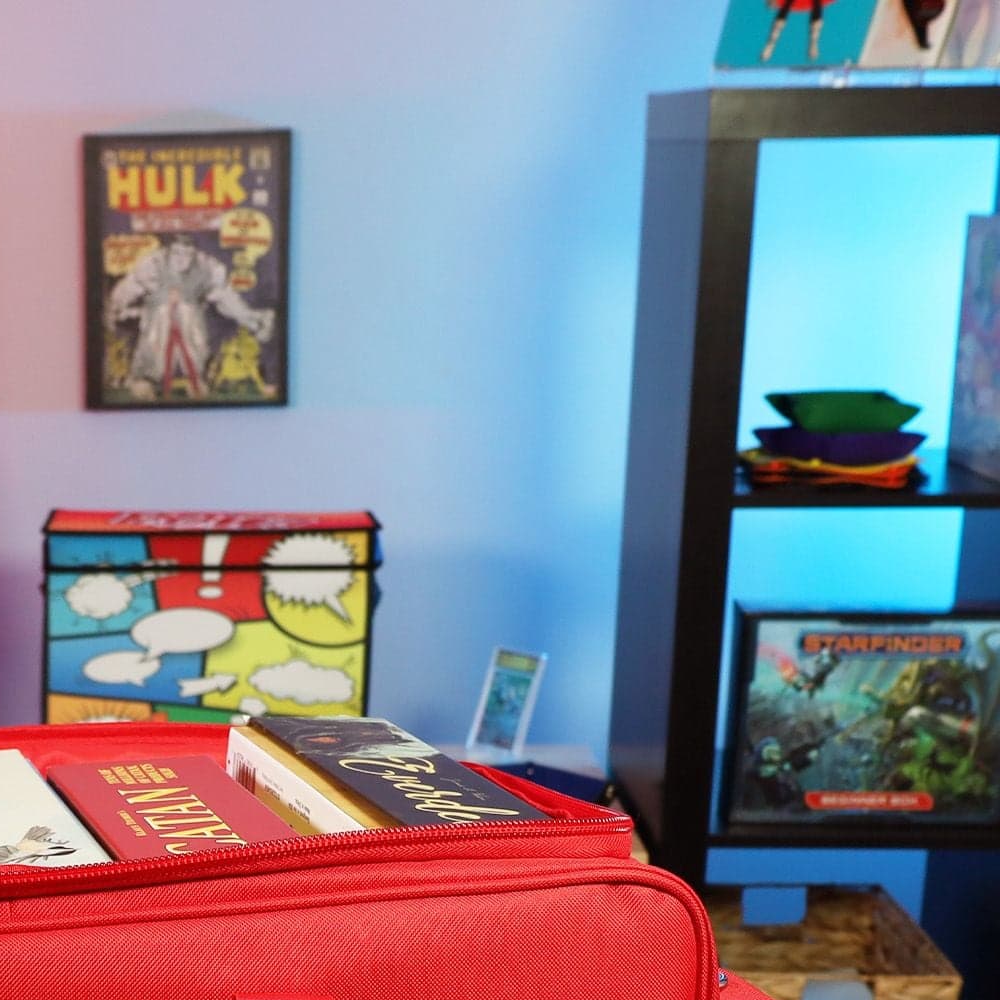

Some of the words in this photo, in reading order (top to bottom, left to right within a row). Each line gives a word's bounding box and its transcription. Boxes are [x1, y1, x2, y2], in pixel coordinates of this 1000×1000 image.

[107, 163, 248, 210] HULK
[803, 633, 963, 653] STARFINDER
[117, 786, 248, 855] CATAN
